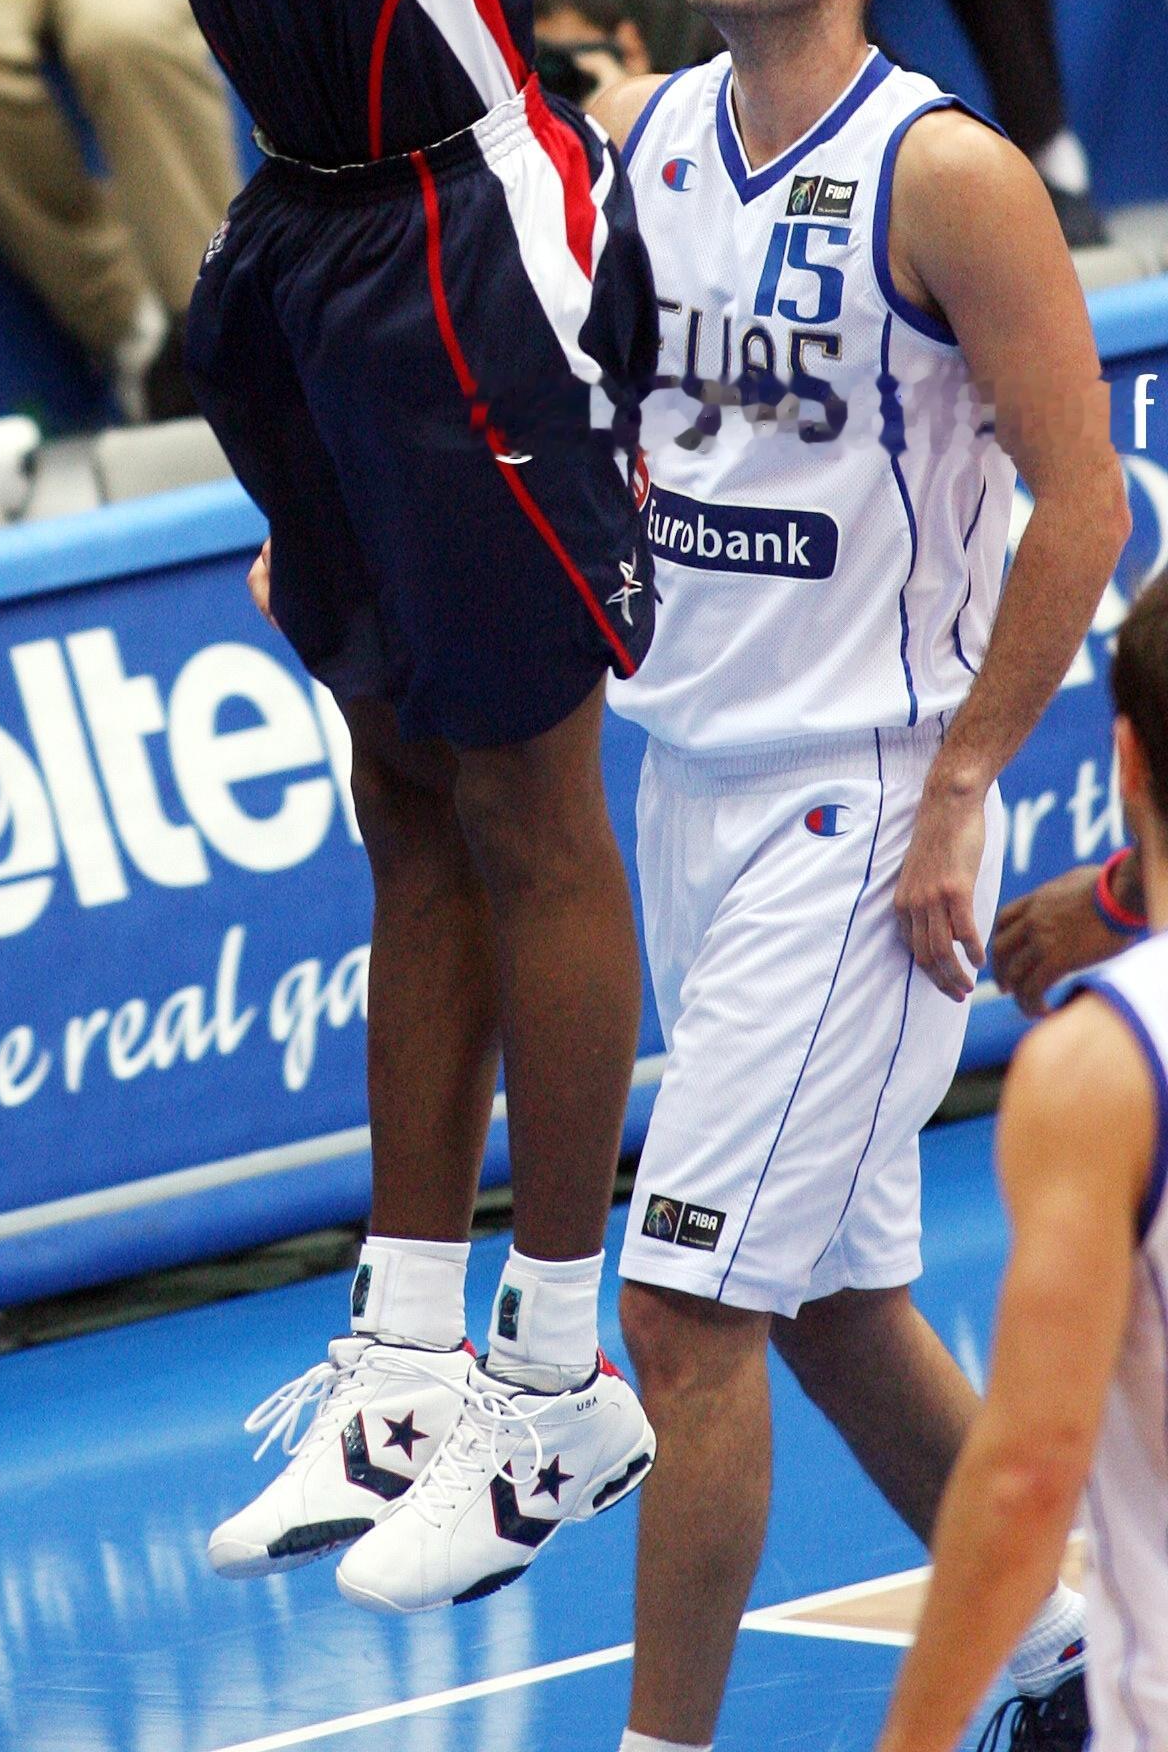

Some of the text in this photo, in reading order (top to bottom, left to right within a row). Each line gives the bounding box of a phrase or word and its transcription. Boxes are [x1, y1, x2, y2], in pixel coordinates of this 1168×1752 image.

[825, 184, 853, 200] FIBA
[754, 222, 852, 324] 15
[647, 499, 811, 567] Eurobank
[63, 923, 259, 1093] real
[269, 943, 372, 1092] ga
[688, 1210, 719, 1231] FIBA
[576, 1396, 598, 1412] USA
